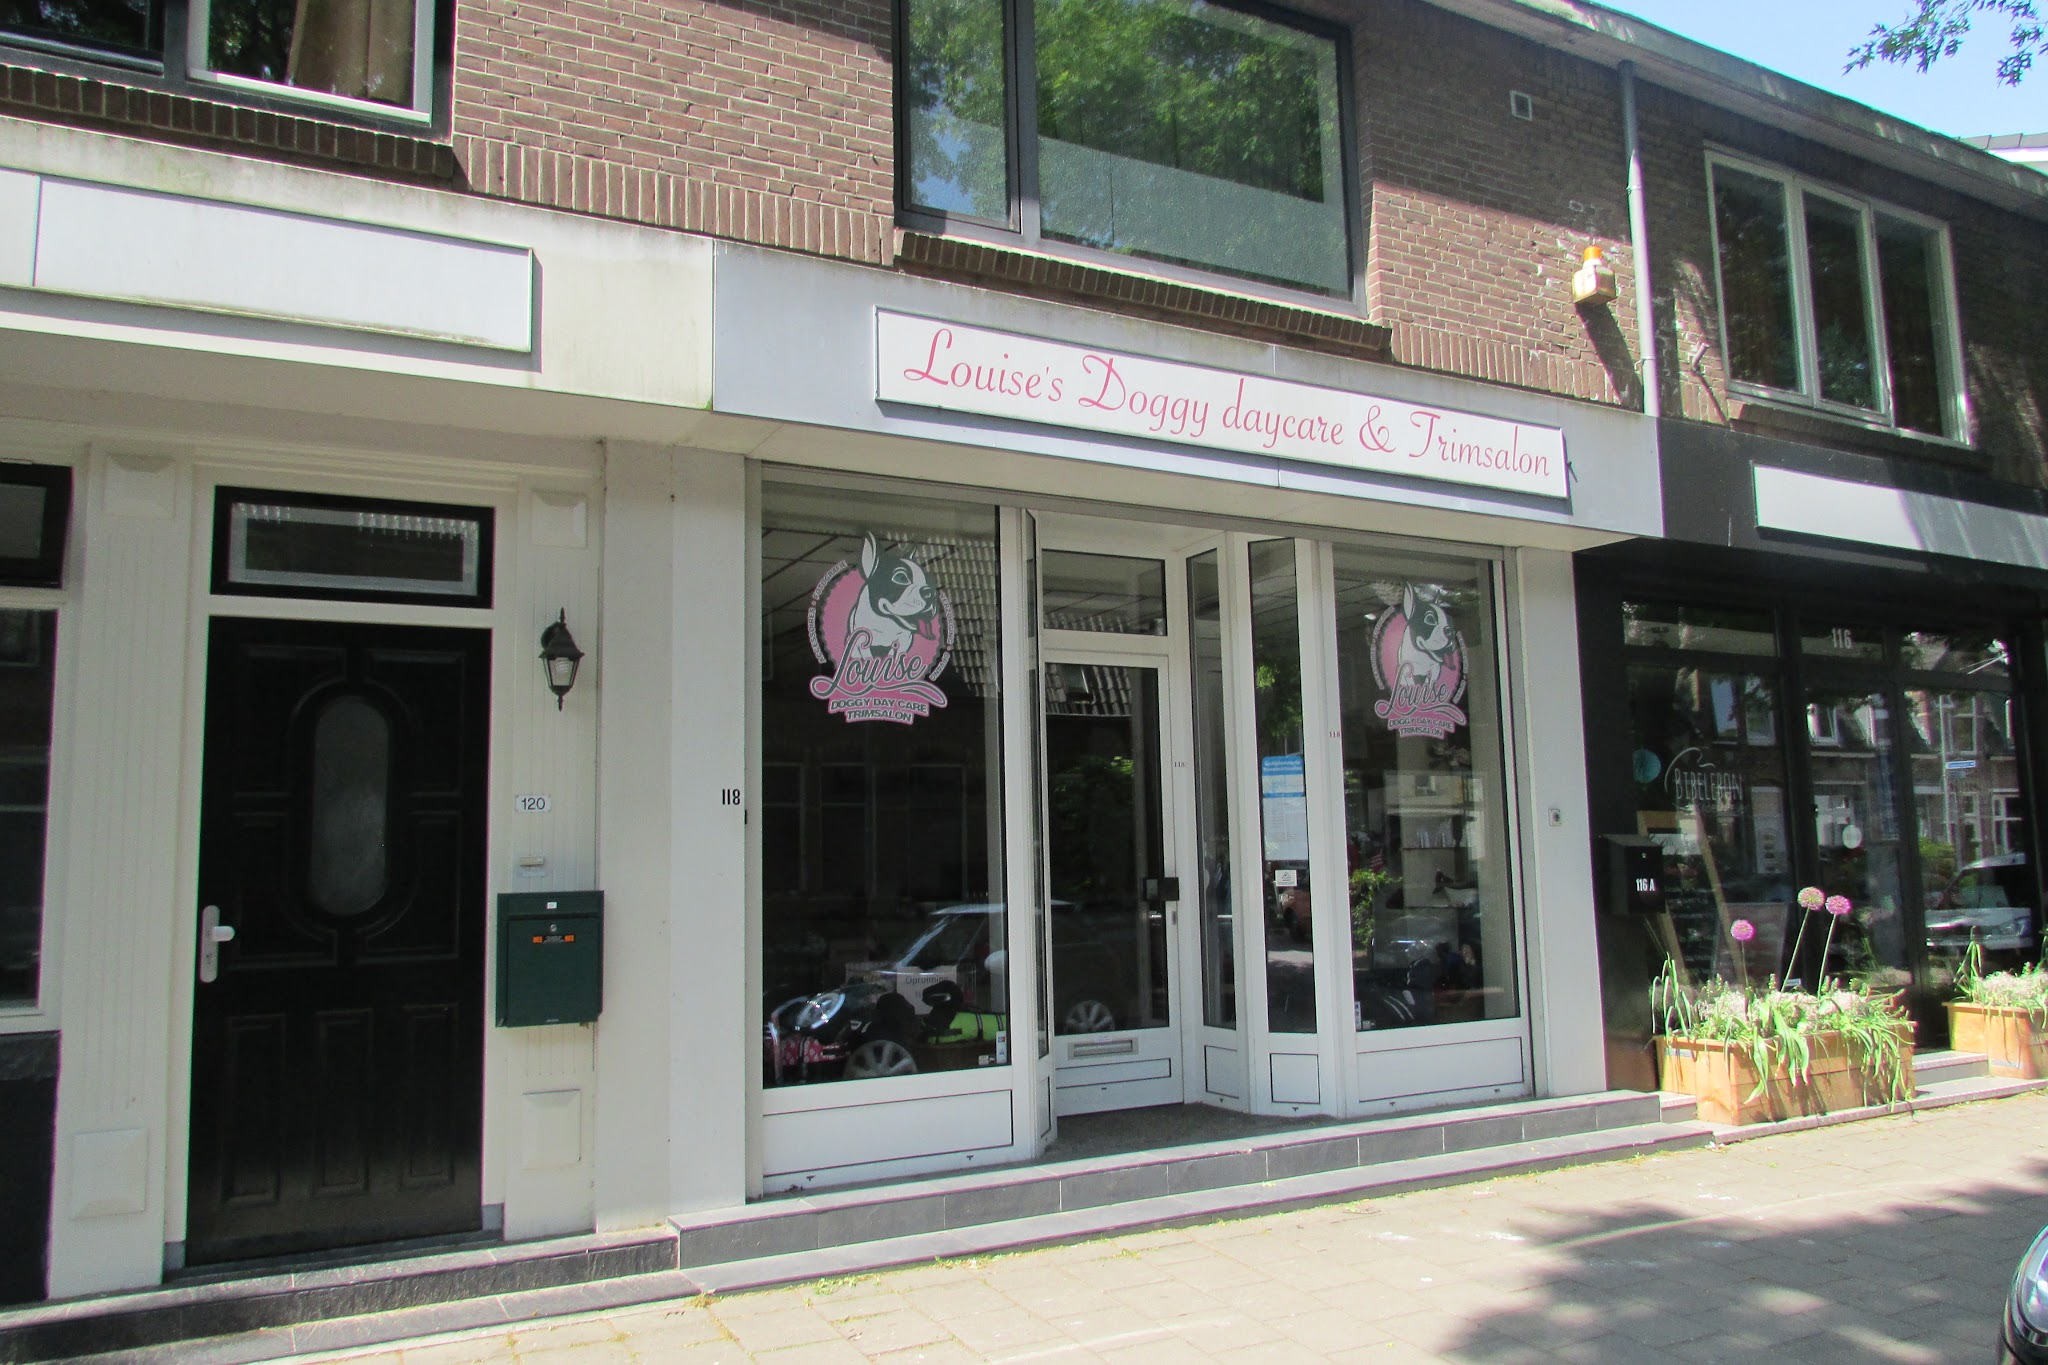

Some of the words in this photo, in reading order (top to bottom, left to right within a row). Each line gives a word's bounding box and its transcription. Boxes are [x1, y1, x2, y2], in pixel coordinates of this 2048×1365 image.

[903, 327, 1063, 402] Louise's
[1078, 353, 1210, 438] Doggy
[1221, 377, 1344, 450] daycare
[1358, 404, 1396, 454] &
[1408, 408, 1551, 478] Trimsalon
[1831, 628, 1852, 649] 116
[811, 628, 930, 700] Louise
[1375, 662, 1452, 718] Louise
[830, 699, 870, 710] DOGGY
[873, 698, 895, 706] DAY
[898, 700, 928, 713] CARE
[847, 709, 912, 721] TRIMSALON
[520, 797, 546, 811] 120
[722, 788, 741, 806] 118
[1635, 878, 1648, 892] 116
[1649, 878, 1656, 892] A
